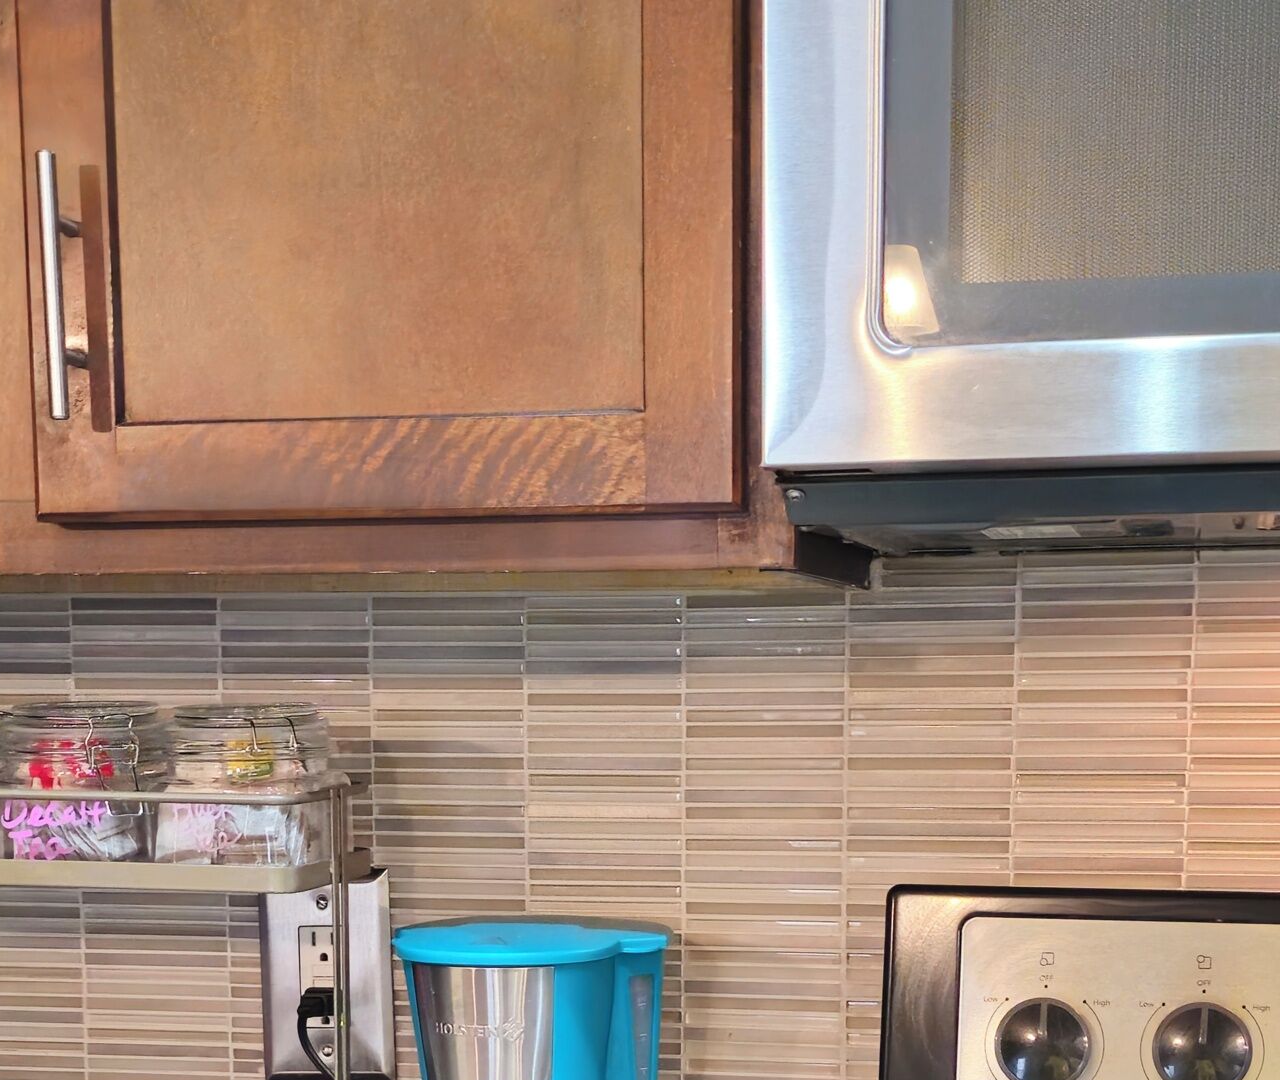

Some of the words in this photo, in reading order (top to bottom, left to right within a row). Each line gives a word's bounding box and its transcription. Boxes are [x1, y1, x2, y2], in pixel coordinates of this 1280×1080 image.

[1038, 974, 1054, 983] OFF
[1196, 979, 1212, 987] OFF
[1093, 999, 1111, 1007] High
[1252, 1004, 1271, 1013] High
